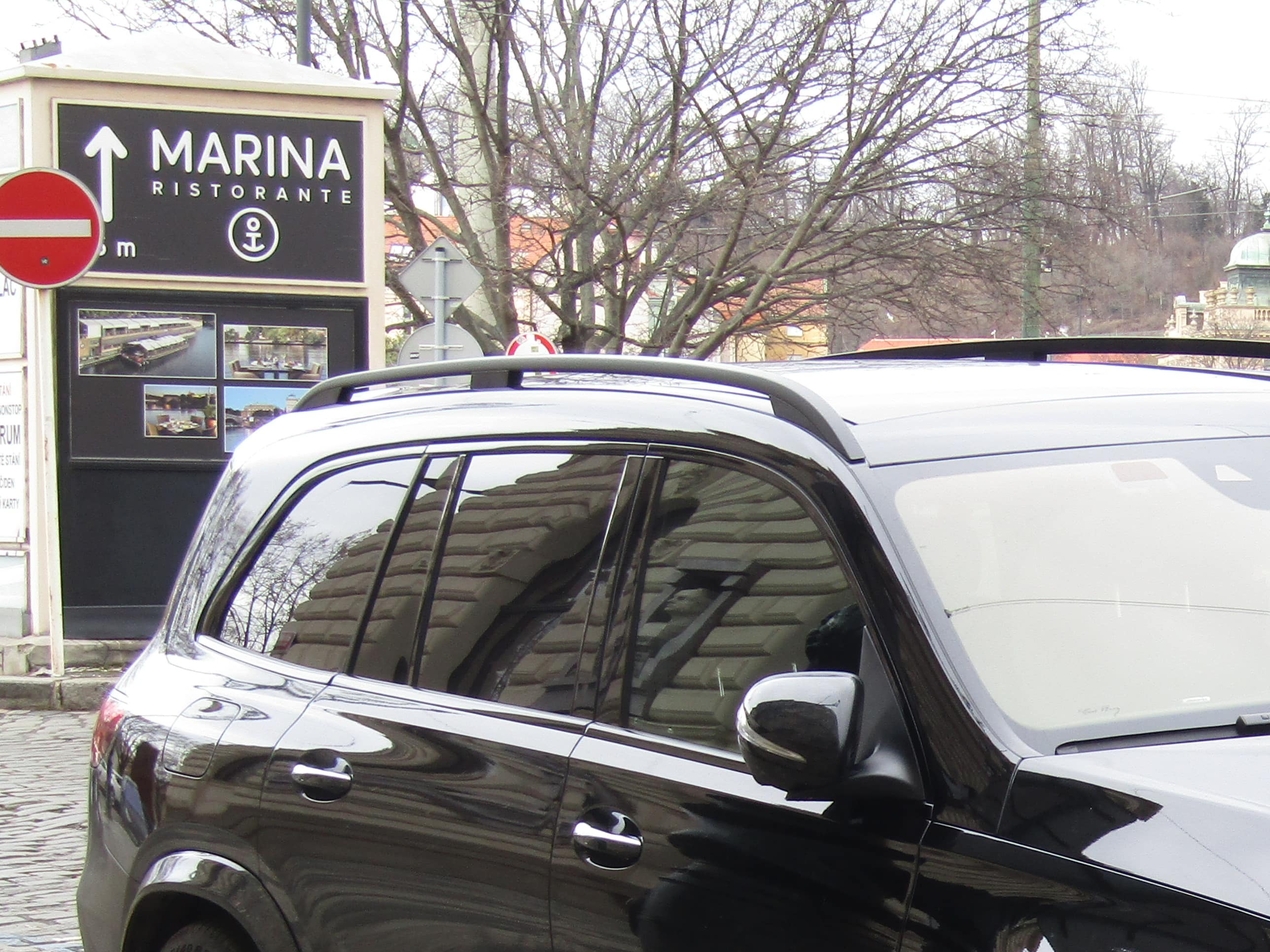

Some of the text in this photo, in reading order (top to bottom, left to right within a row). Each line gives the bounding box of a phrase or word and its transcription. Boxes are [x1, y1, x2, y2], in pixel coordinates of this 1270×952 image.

[152, 128, 351, 181] MARINA
[152, 181, 351, 204] RISTORANTE
[117, 241, 136, 258] m
[0, 276, 17, 297] AC
